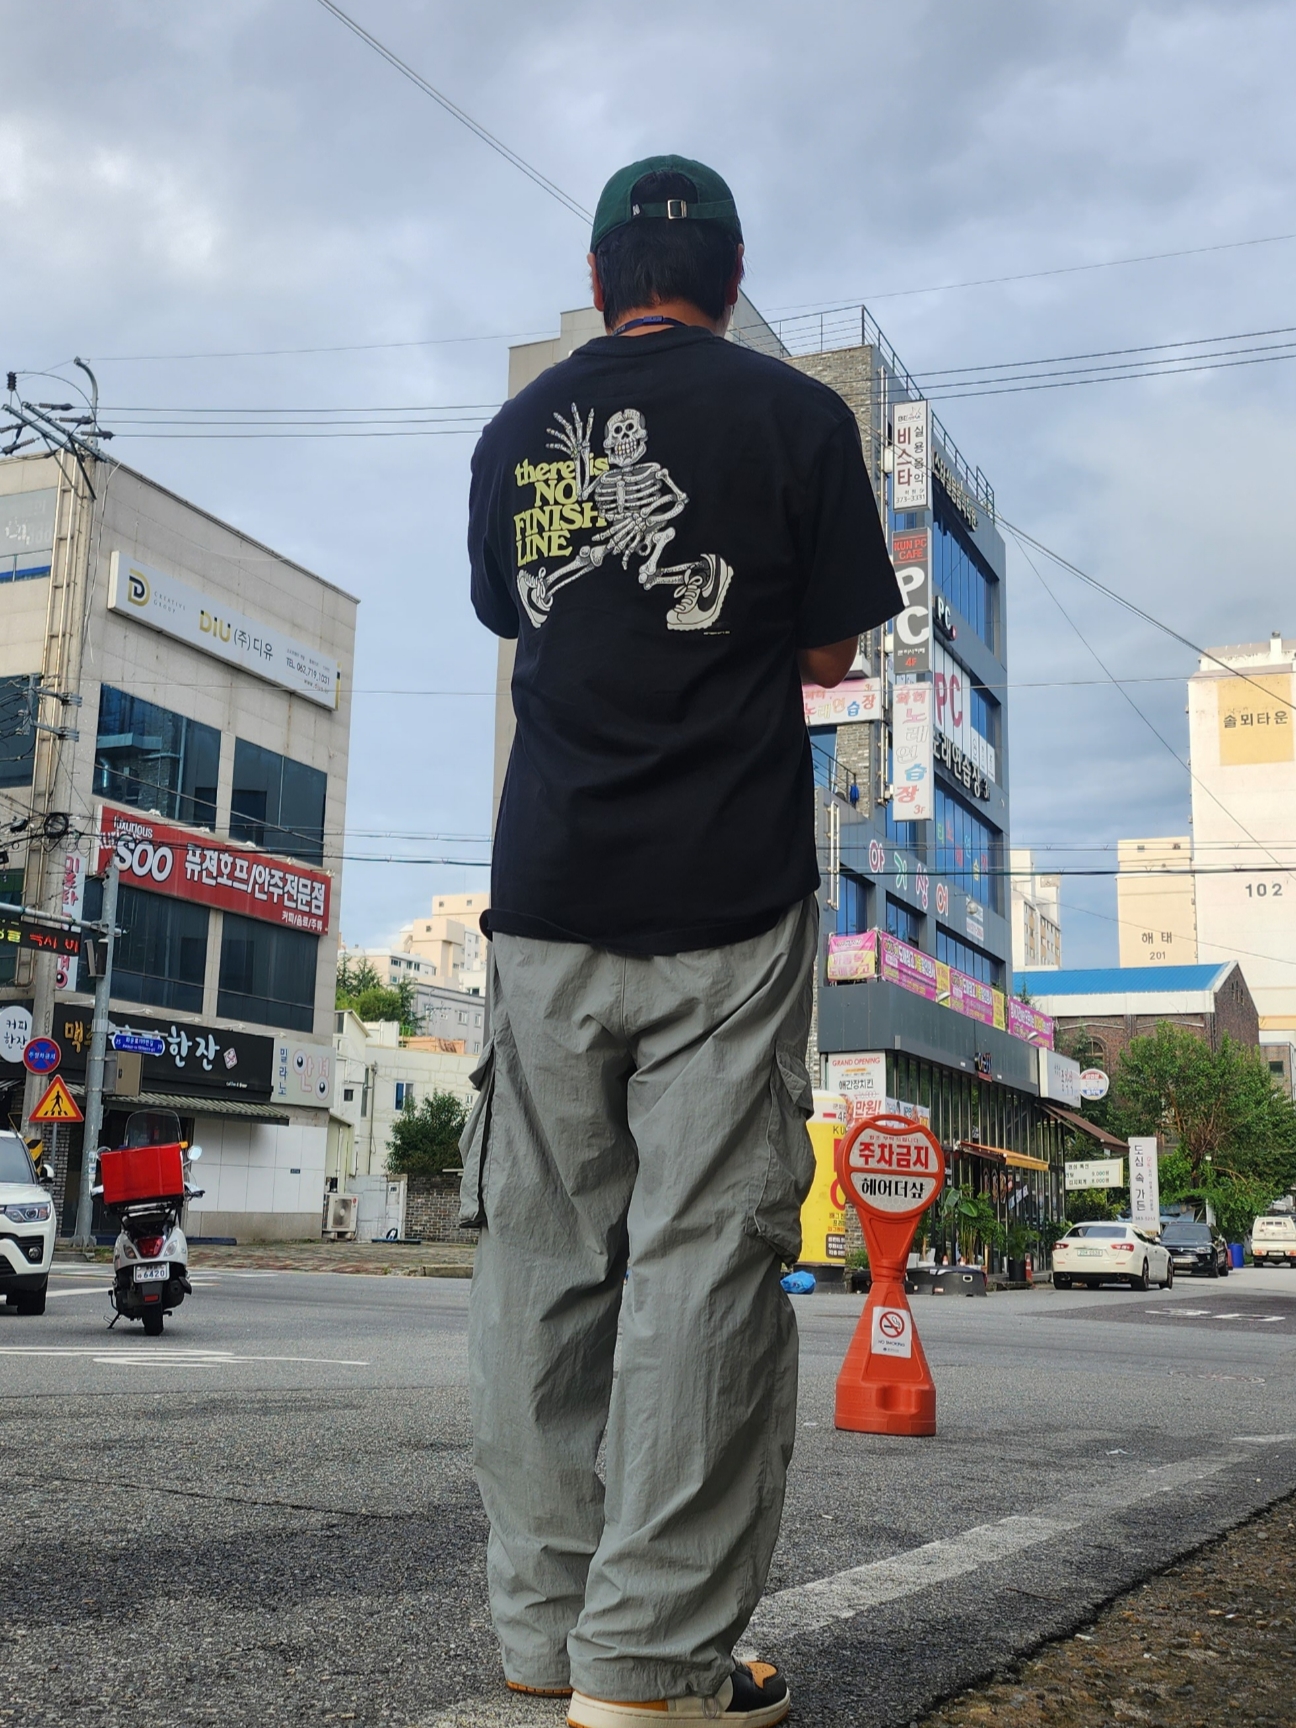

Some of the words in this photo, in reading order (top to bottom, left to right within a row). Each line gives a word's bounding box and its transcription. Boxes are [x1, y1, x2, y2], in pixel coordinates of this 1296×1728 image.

[896, 427, 912, 486] 비스타
[515, 459, 575, 486] there
[589, 452, 609, 476] is
[535, 478, 577, 507] NO
[514, 503, 607, 539] FINISH
[516, 529, 572, 567] LINE
[894, 540, 912, 551] KUN
[915, 538, 927, 548] PC
[899, 549, 923, 560] CAFE
[905, 657, 917, 667] 4F
[805, 693, 877, 719] 노래연습장
[934, 672, 963, 728] PC
[1223, 711, 1288, 728] 솔뫼타운
[114, 816, 153, 839] luxurious
[114, 834, 173, 882] SOO
[1245, 883, 1283, 897] 102
[1149, 951, 1166, 960] 201
[5, 1018, 28, 1031] 커피
[3, 1032, 28, 1050] 한잔
[278, 1048, 288, 1097] 밀라노
[832, 1058, 853, 1067] GRAND
[854, 1056, 881, 1065] OPENING
[292, 1048, 331, 1101] 안경
[855, 1100, 881, 1117] 만원!
[859, 1142, 929, 1169] 주차금지
[1134, 1145, 1144, 1167] 도심
[1135, 1189, 1146, 1211] 가든
[143, 1269, 165, 1279] 6420
